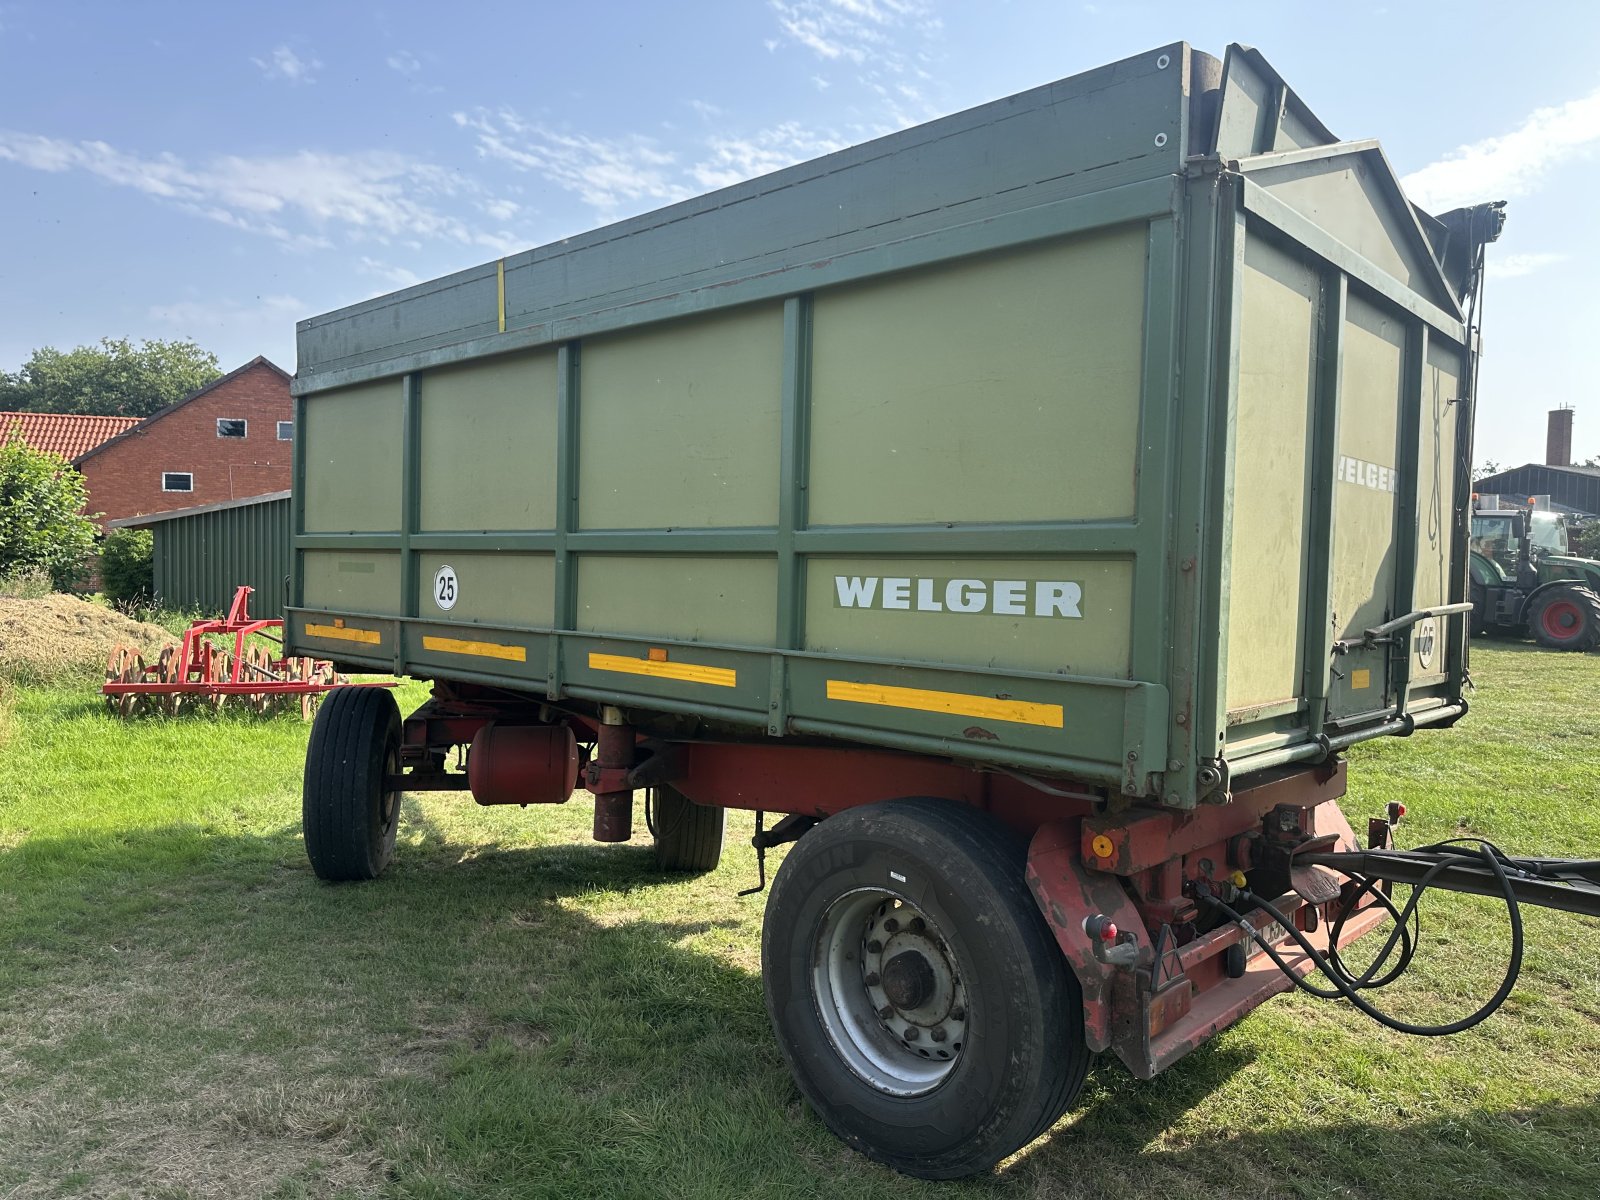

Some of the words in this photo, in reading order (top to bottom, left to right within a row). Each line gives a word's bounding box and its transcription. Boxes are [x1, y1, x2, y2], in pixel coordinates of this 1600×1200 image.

[439, 576, 454, 601] 25
[835, 576, 1082, 618] WELGER
[1422, 625, 1434, 656] 25
